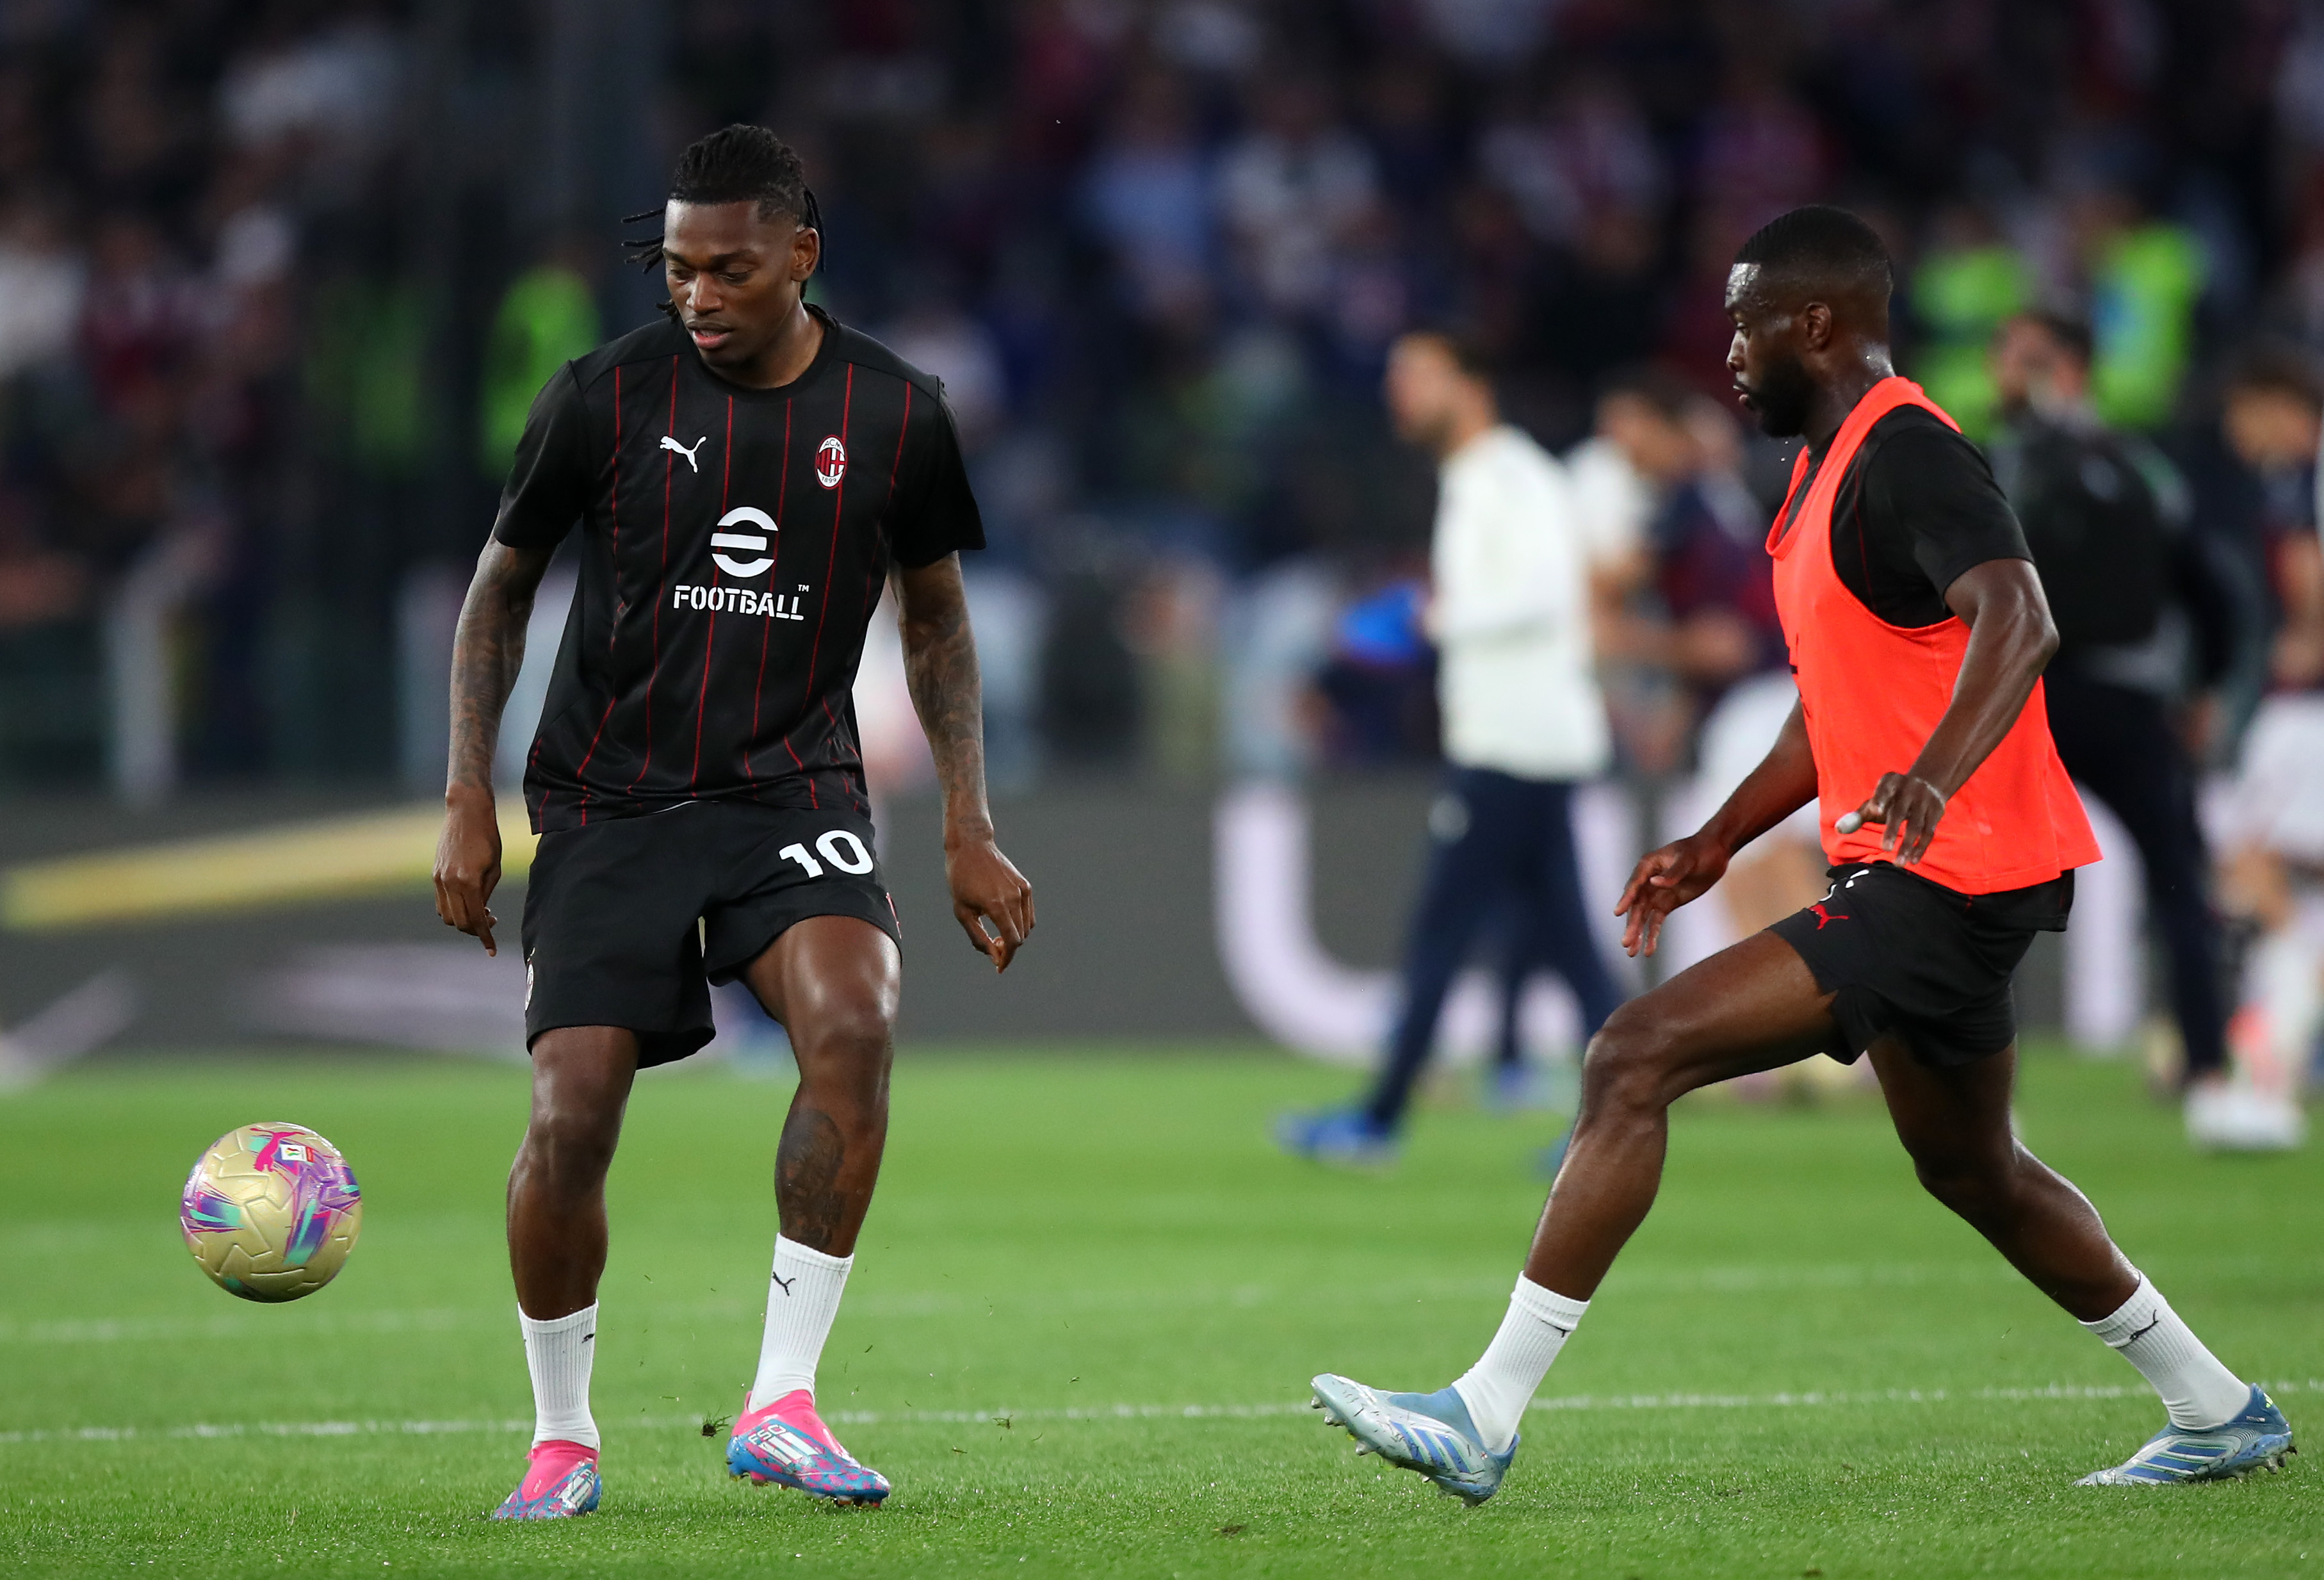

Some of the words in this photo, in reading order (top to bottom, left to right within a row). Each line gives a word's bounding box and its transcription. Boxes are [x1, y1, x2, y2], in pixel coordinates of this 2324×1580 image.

[824, 439, 841, 450] ACM
[674, 585, 804, 621] FOOTBALL
[779, 830, 874, 878] 10
